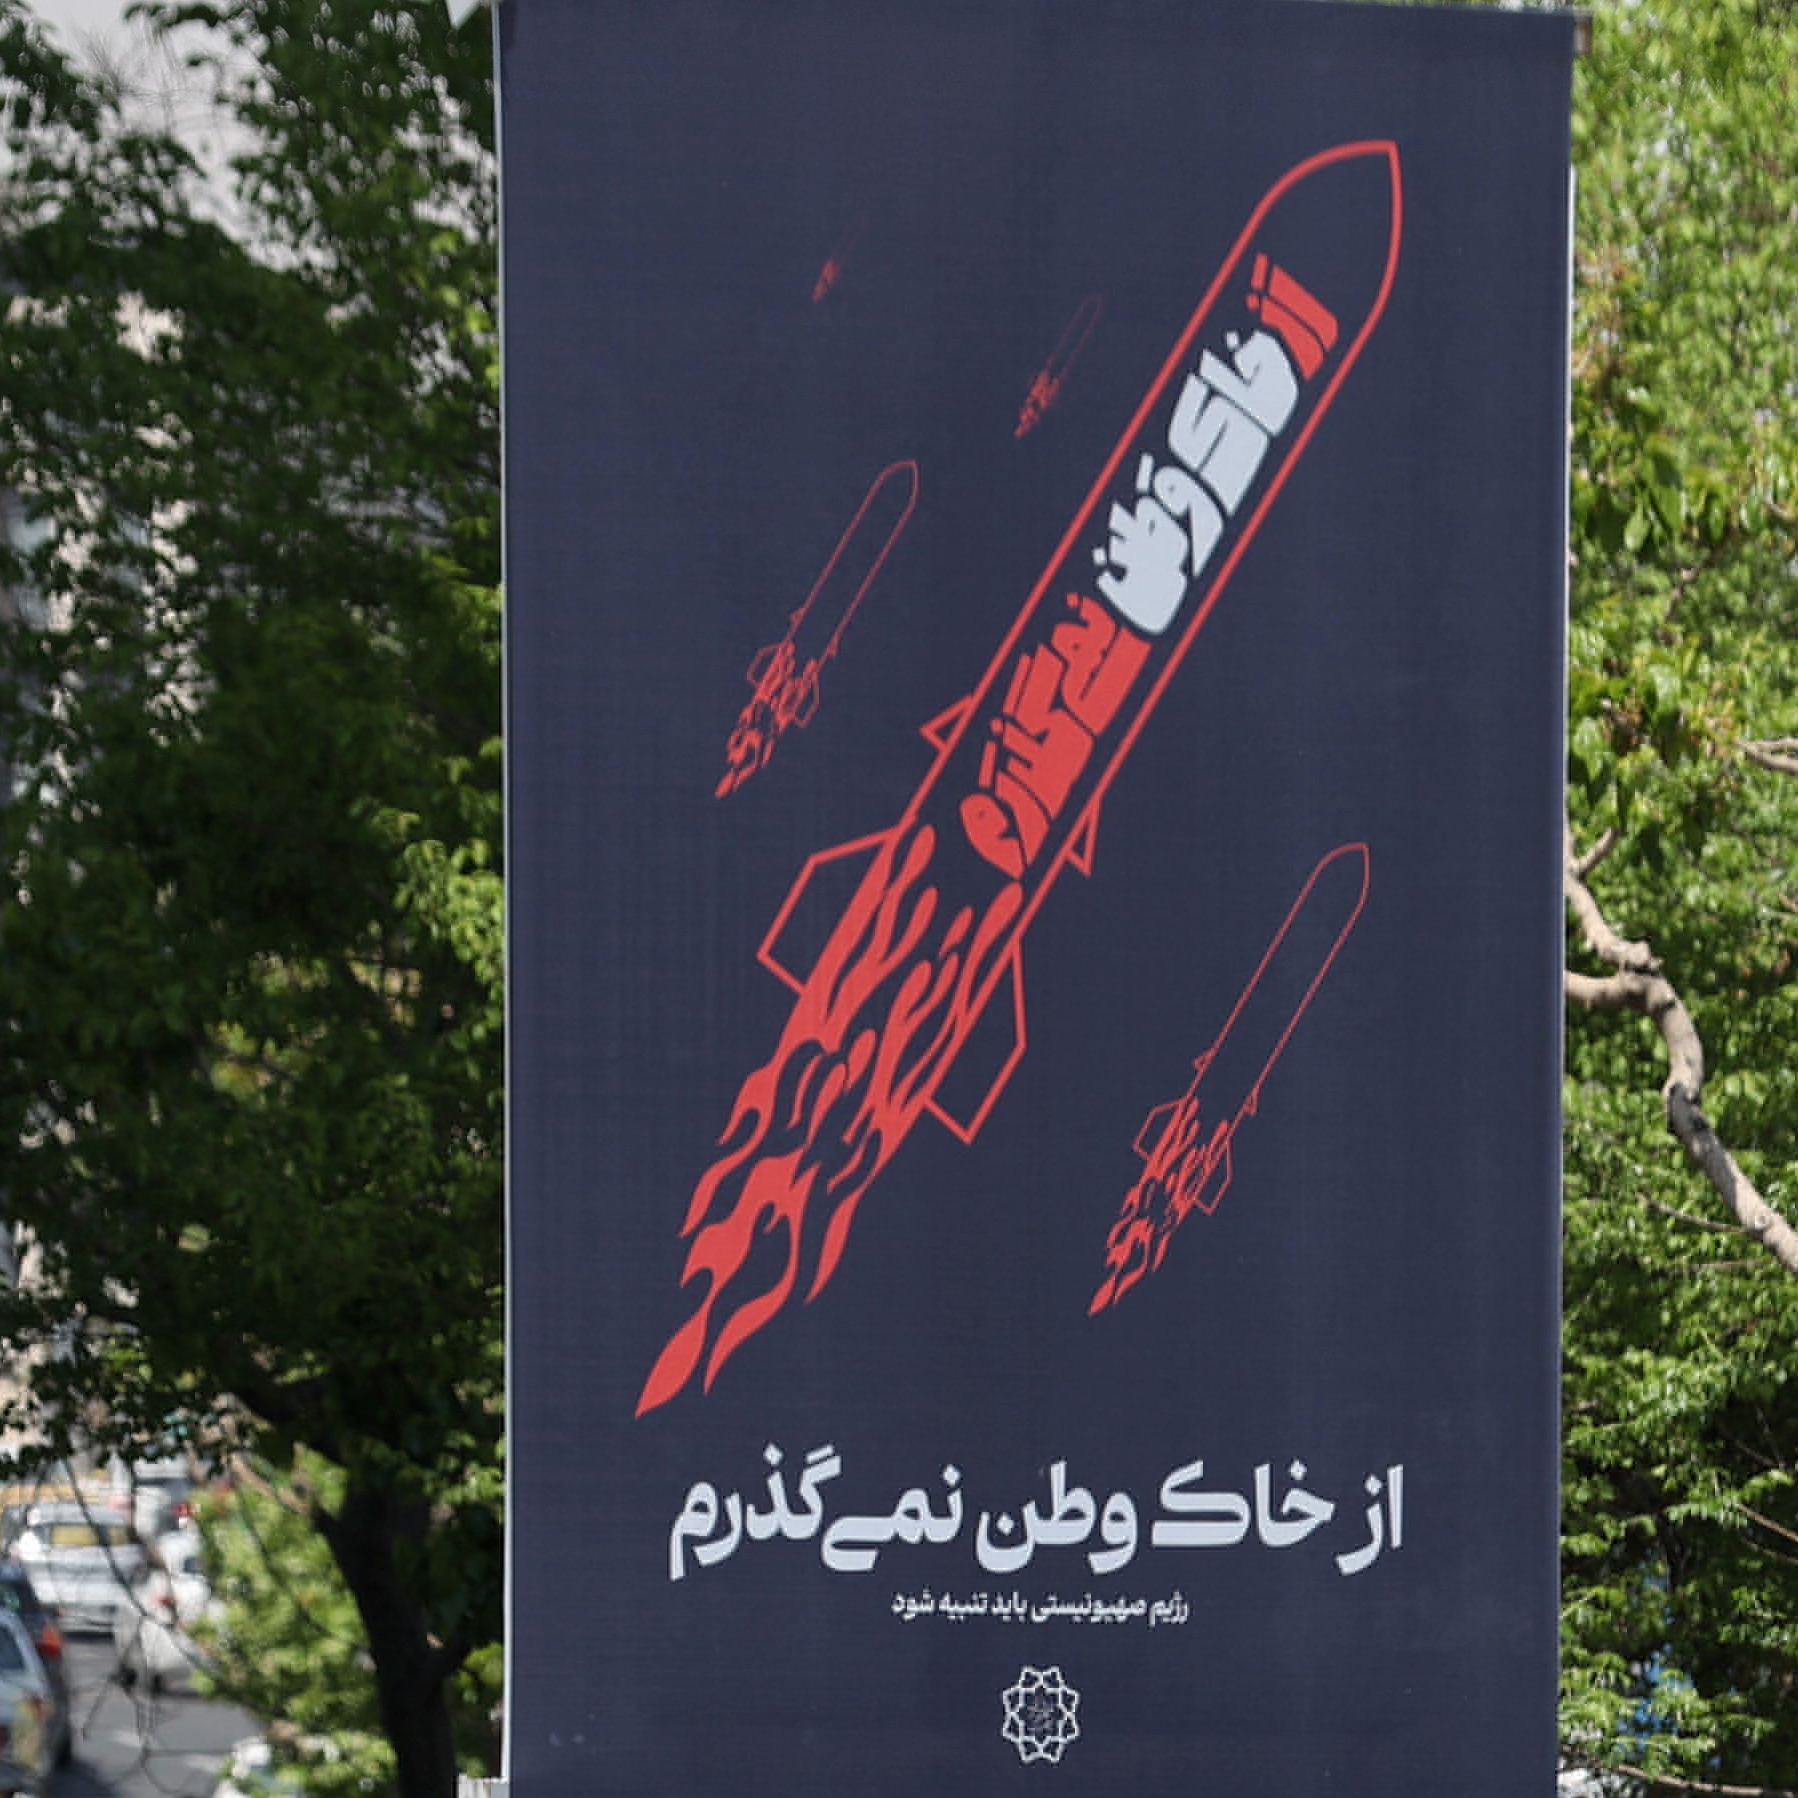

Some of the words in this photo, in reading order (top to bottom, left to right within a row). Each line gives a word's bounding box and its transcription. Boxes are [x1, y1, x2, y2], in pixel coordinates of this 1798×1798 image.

[976, 1460, 1138, 1574] وطن
[1151, 1460, 1335, 1547] خاک
[1336, 1464, 1404, 1575] از
[891, 1588, 935, 1621] شود
[991, 1592, 1028, 1622] باید
[1149, 1588, 1190, 1628] رژیم
